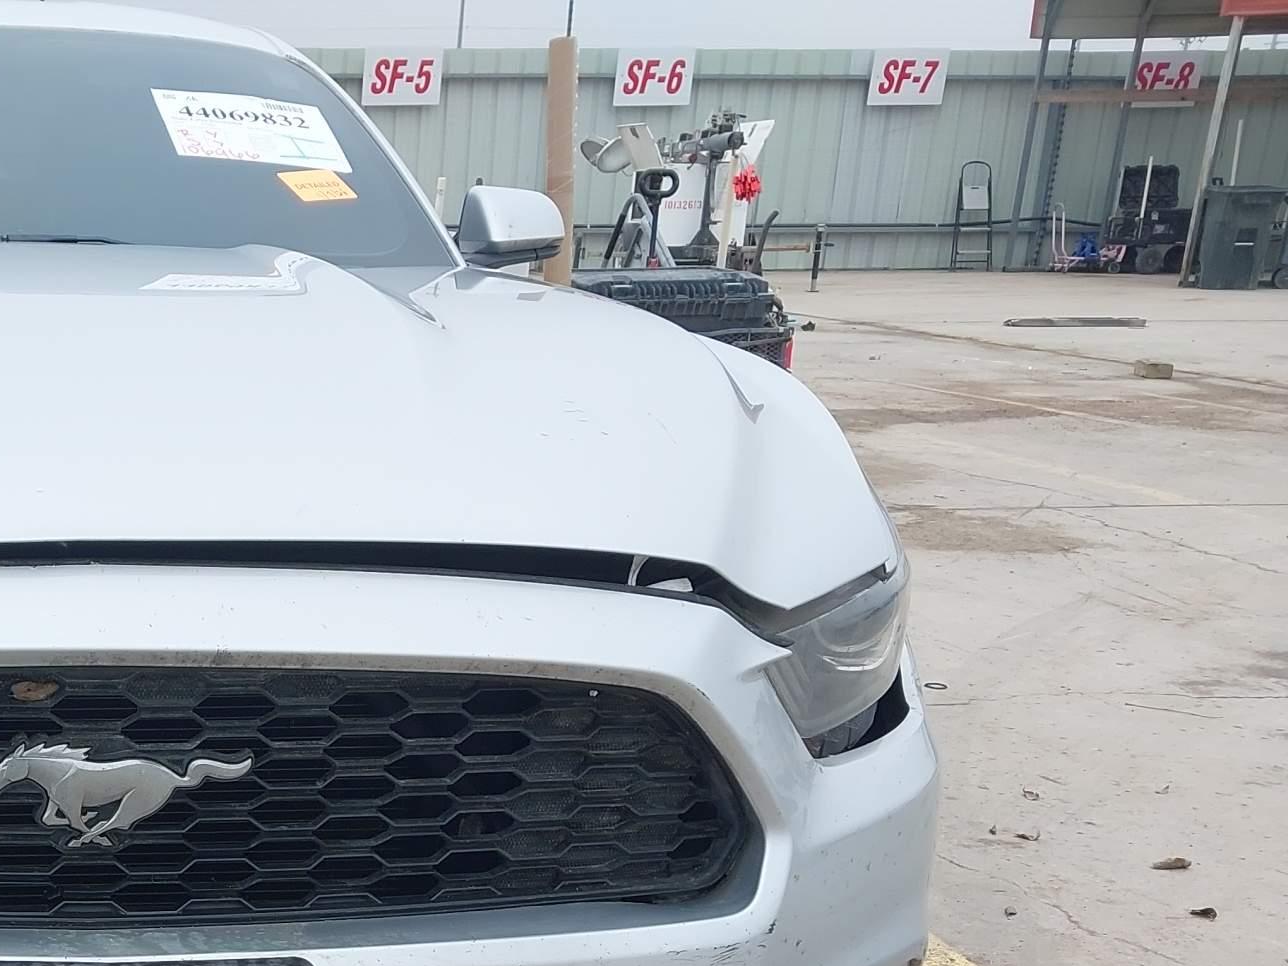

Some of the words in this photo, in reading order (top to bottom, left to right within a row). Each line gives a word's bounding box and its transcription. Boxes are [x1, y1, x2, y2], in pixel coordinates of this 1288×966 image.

[369, 58, 434, 95] SF-5
[622, 58, 687, 95] SF-6
[877, 57, 941, 95] SF-7
[1136, 61, 1196, 91] SF-8
[178, 105, 310, 129] 44069832
